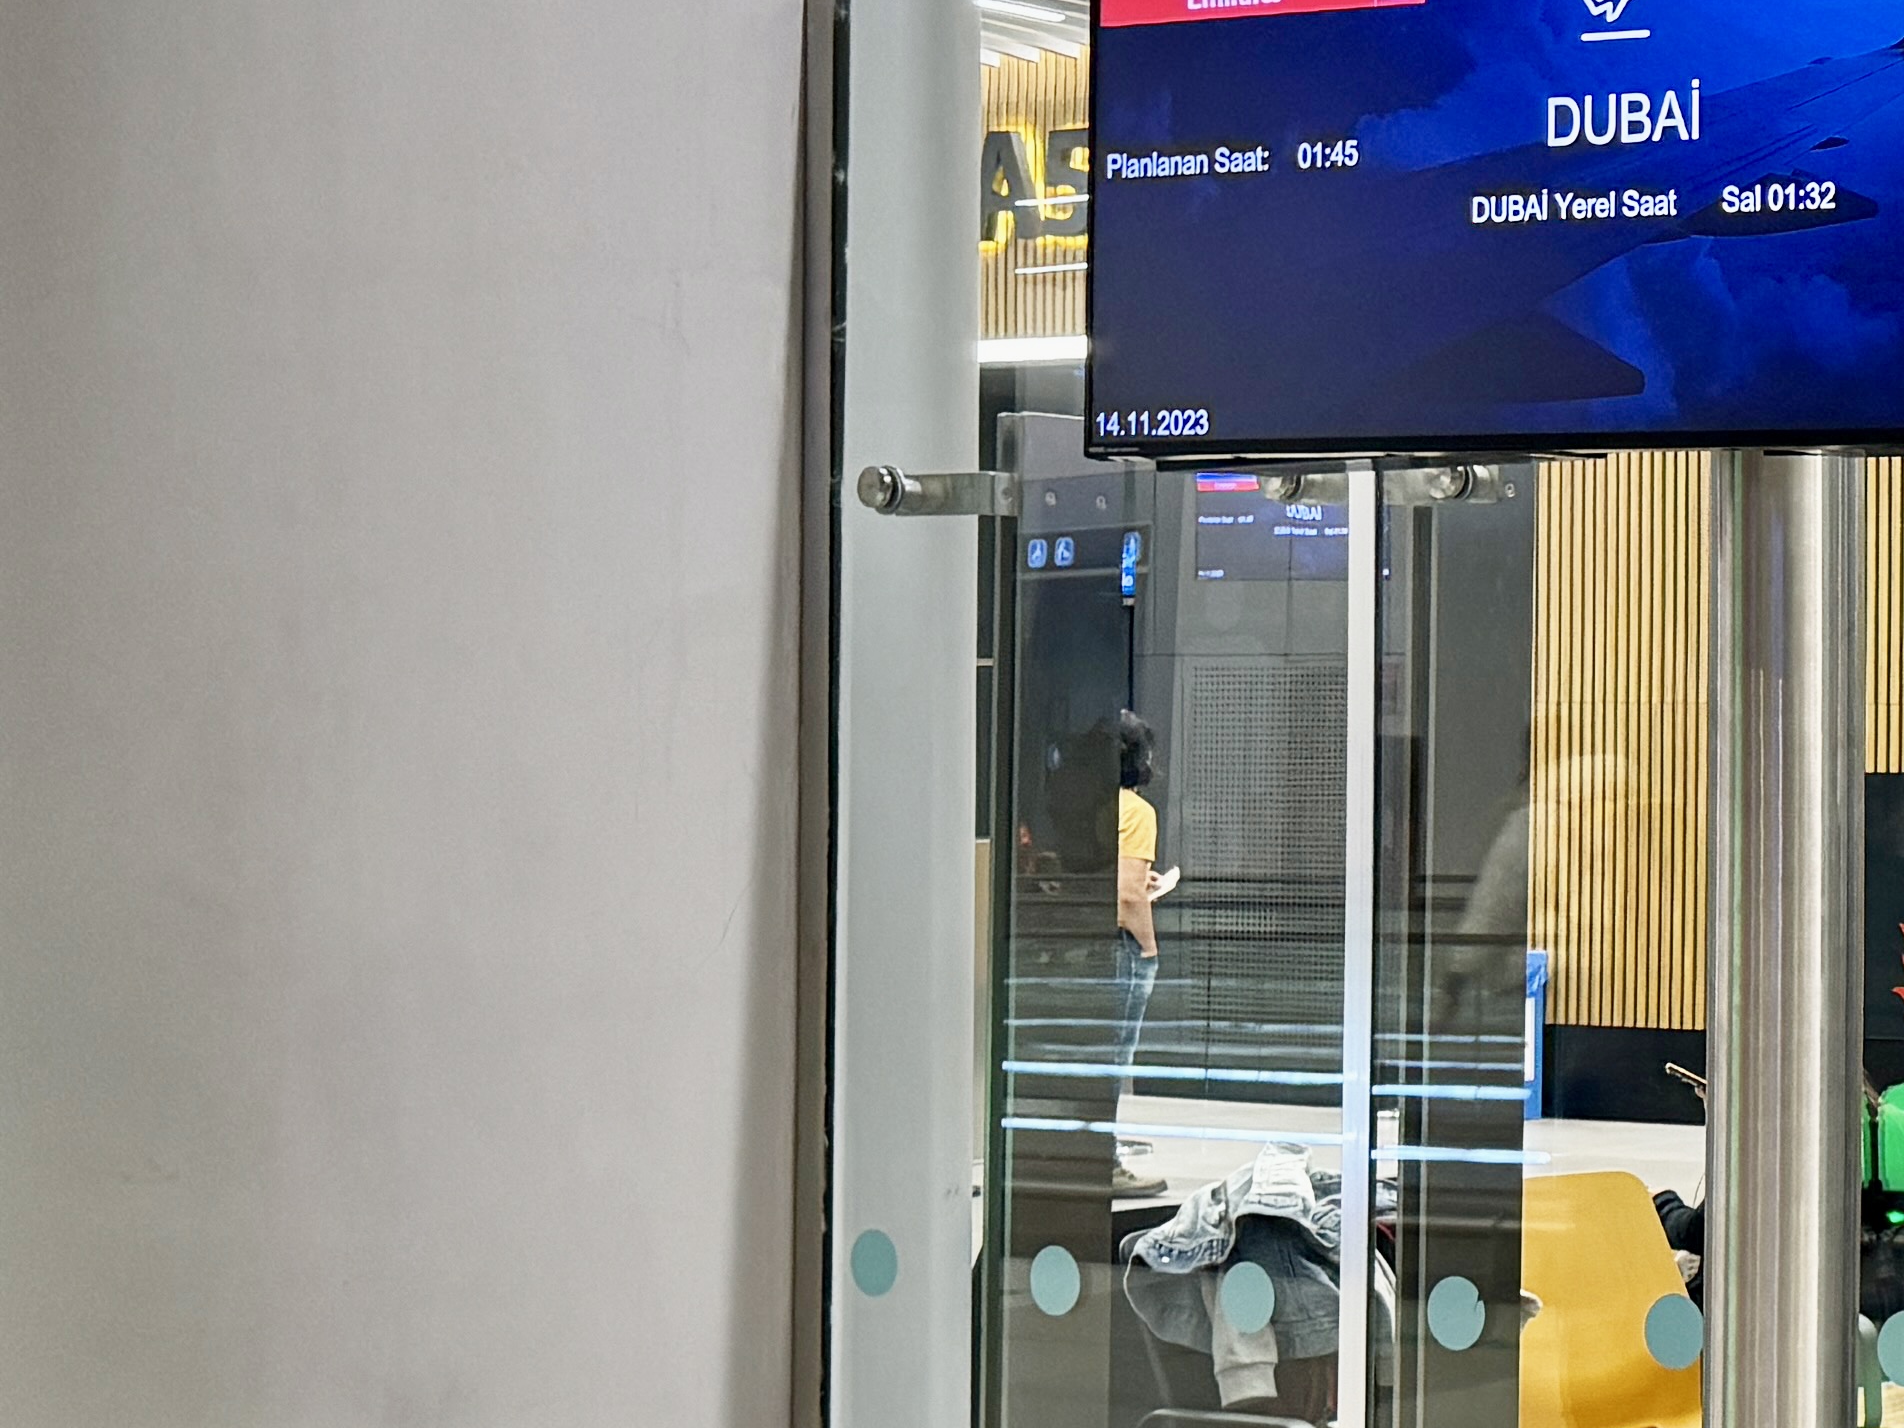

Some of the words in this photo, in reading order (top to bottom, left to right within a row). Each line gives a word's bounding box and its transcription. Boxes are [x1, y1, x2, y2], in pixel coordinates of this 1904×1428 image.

[1547, 78, 1701, 147] DUBAİ
[1106, 150, 1209, 180] Planlanan
[1213, 145, 1270, 174] Saat:
[1297, 139, 1359, 170] 01:45
[1471, 188, 1549, 224] DUBAİ
[1553, 190, 1616, 220] Yerel
[1621, 188, 1678, 218] Saat
[1721, 183, 1762, 214] Sal
[1767, 180, 1836, 212] 01:32
[1095, 408, 1209, 437] 14.11.2023
